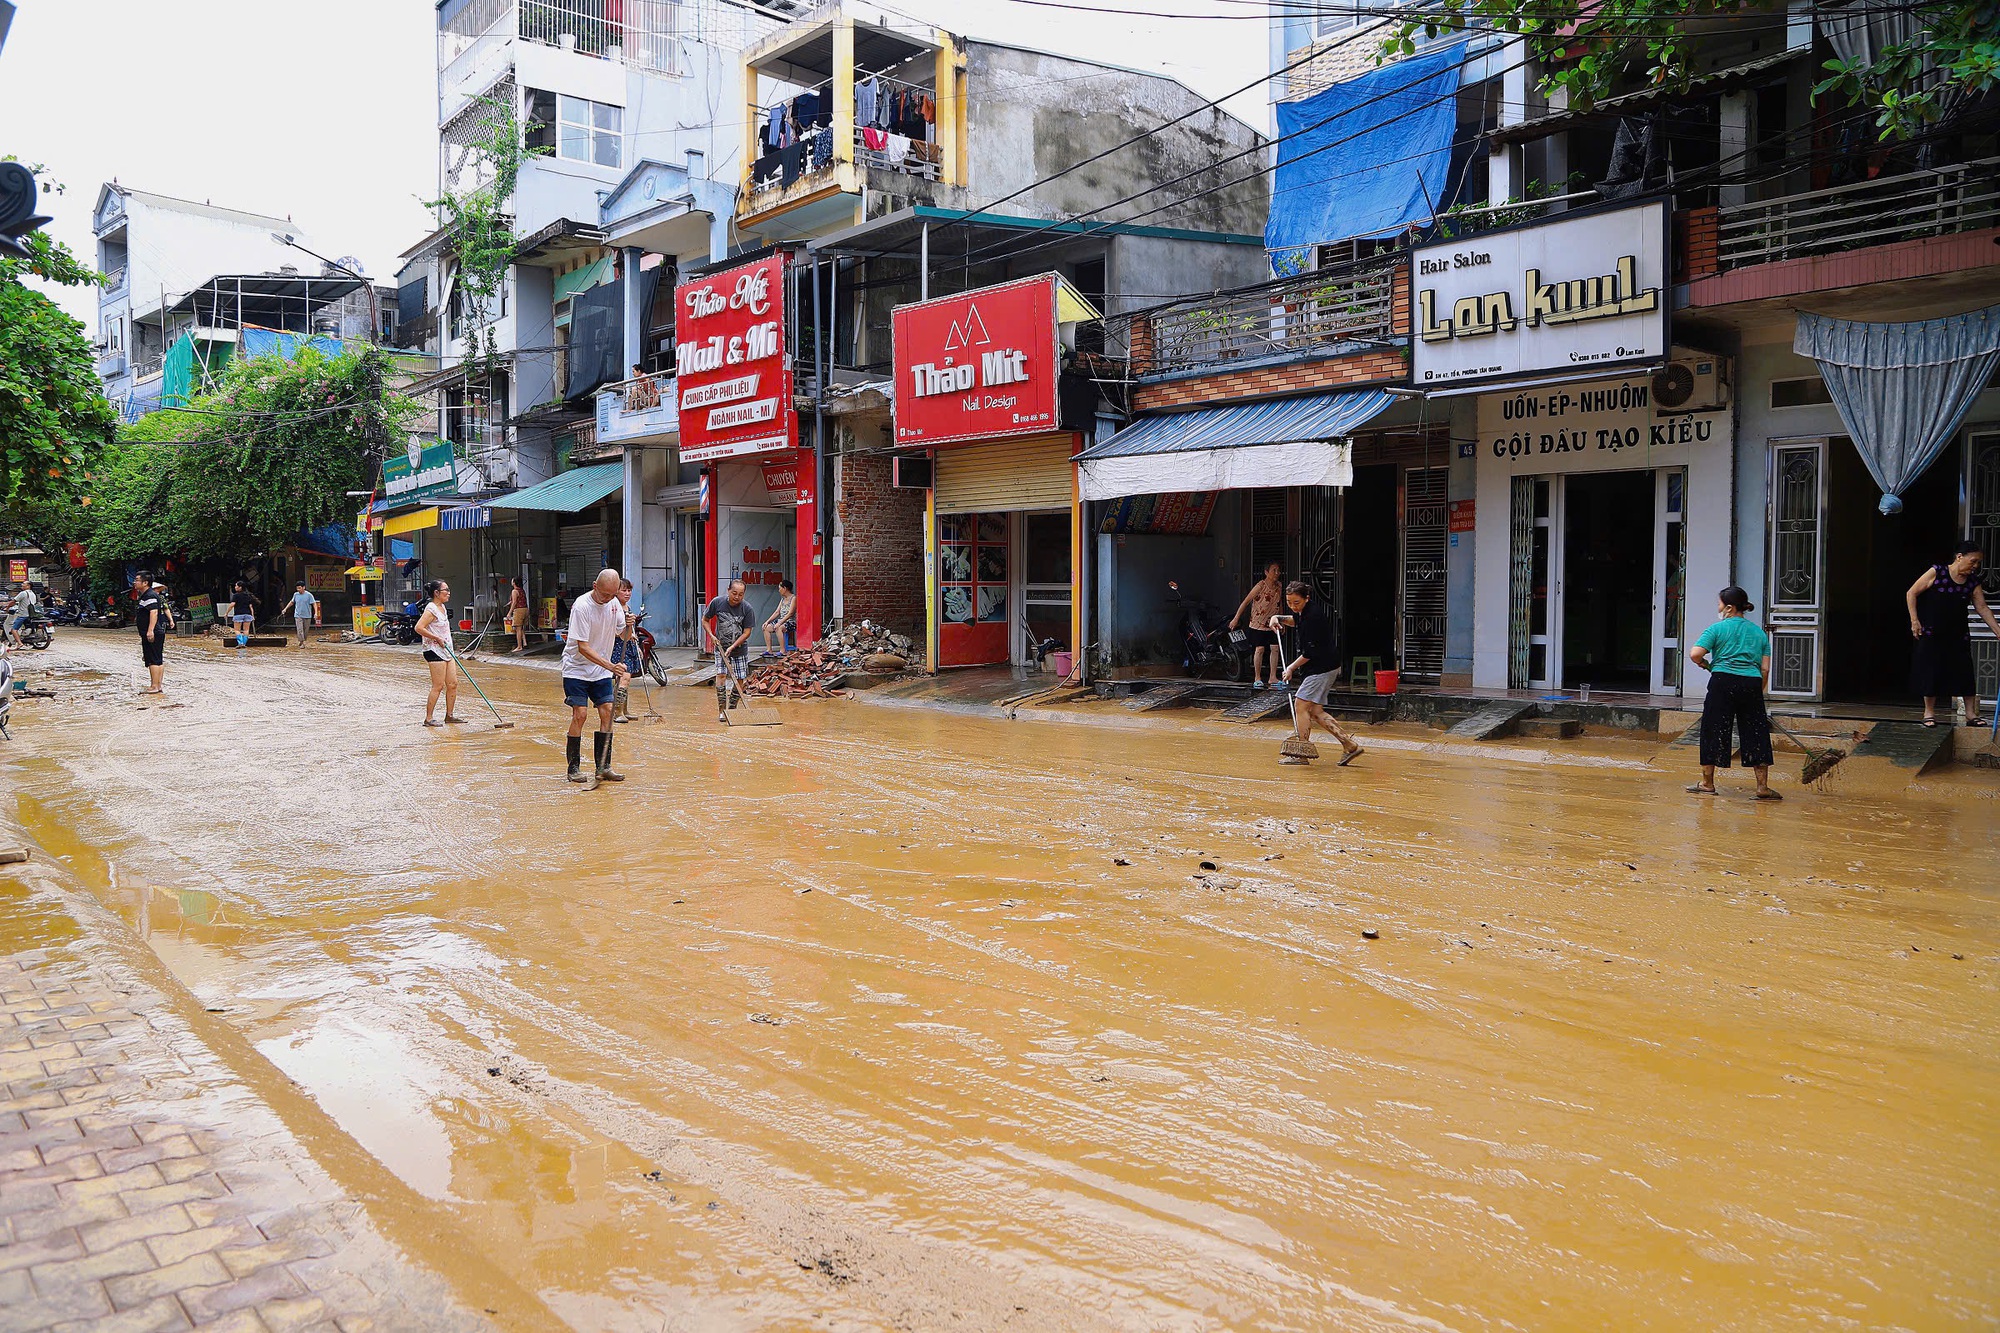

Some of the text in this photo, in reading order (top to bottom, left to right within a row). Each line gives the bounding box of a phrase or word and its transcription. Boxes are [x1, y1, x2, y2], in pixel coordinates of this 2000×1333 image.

[1420, 251, 1491, 275] Hair Salon
[686, 285, 726, 319] Thảo
[1420, 289, 1518, 343] Lan
[676, 322, 778, 376] Nail & Mi
[910, 348, 1029, 398] Thảo Mít
[686, 380, 749, 405] CUNG CẤP PHỤ LIỆU
[984, 394, 1016, 410] Design
[711, 410, 736, 426] NGÀNH
[737, 408, 754, 422] NAIL
[760, 404, 770, 418] MI
[1464, 446, 1473, 455] 45
[1540, 428, 1588, 454] ĐẦU
[1595, 427, 1640, 452] TẠO
[766, 469, 796, 486] CHUYÊN
